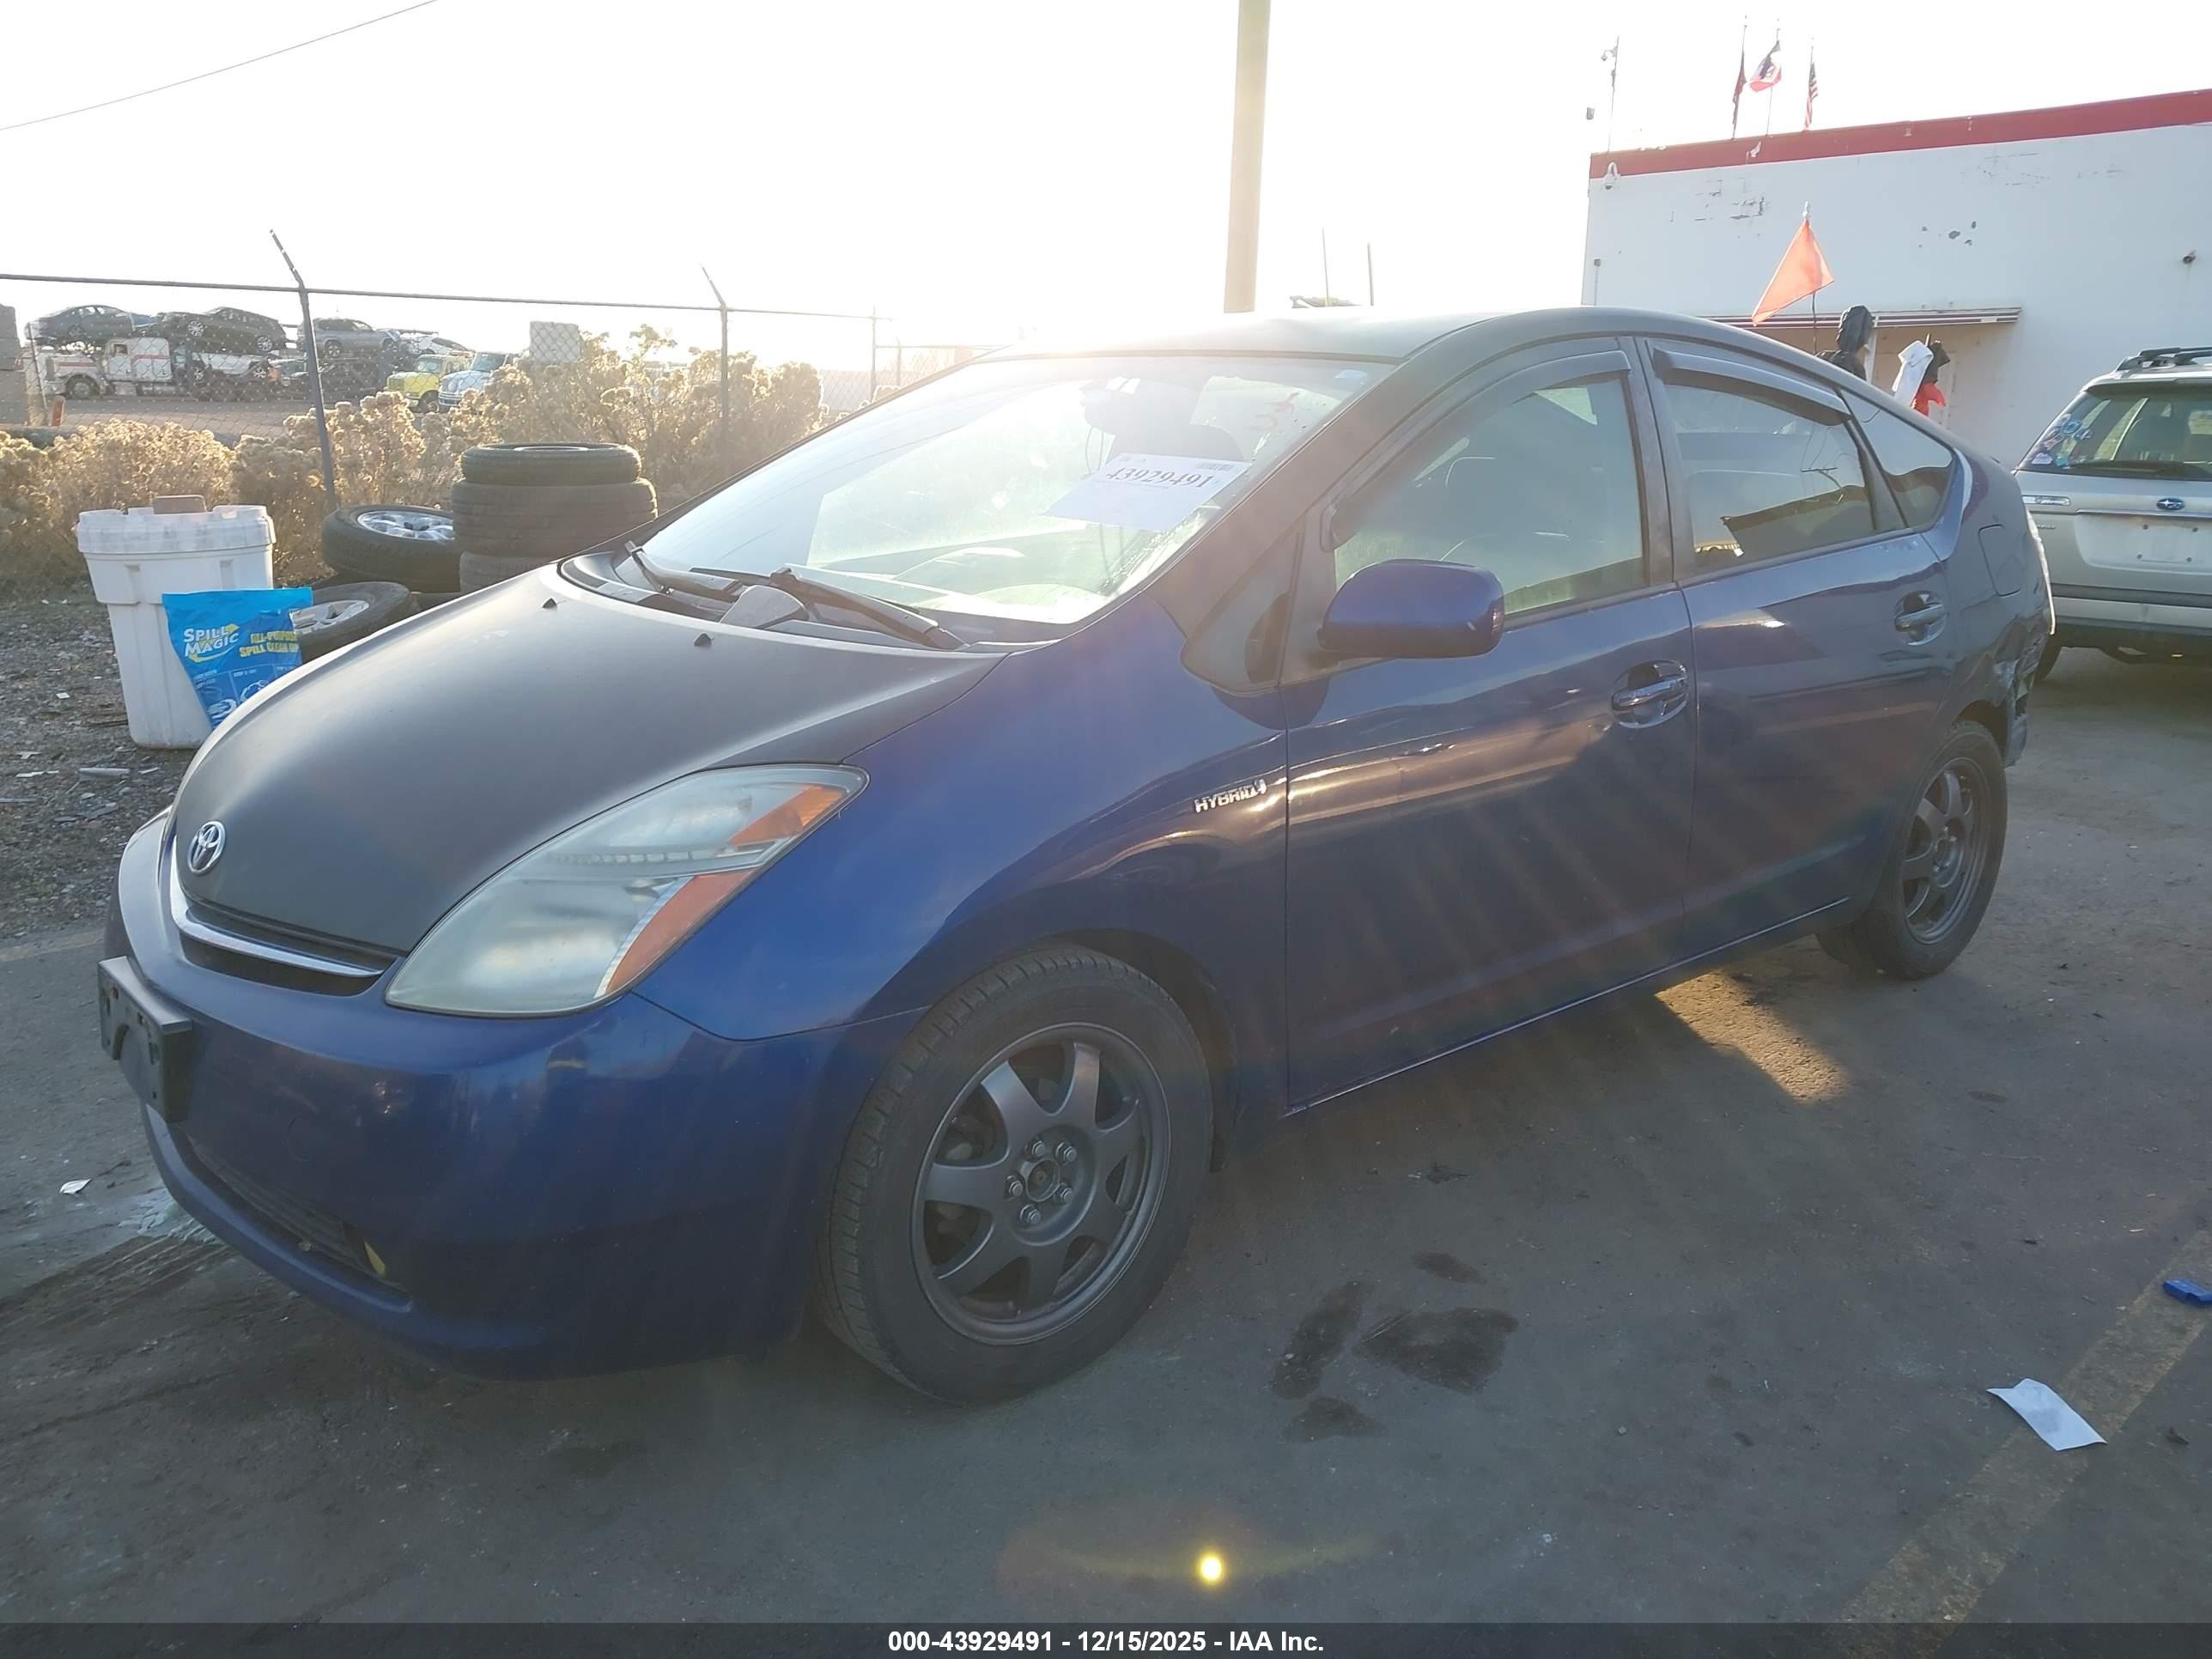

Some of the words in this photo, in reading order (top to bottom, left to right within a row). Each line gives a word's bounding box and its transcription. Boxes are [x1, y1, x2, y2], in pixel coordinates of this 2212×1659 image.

[1106, 467, 1214, 488] 43929491
[184, 626, 228, 642] SPILL
[185, 633, 239, 657] MAGIC
[240, 644, 266, 658] SPILL
[1194, 784, 1259, 813] HYBRID
